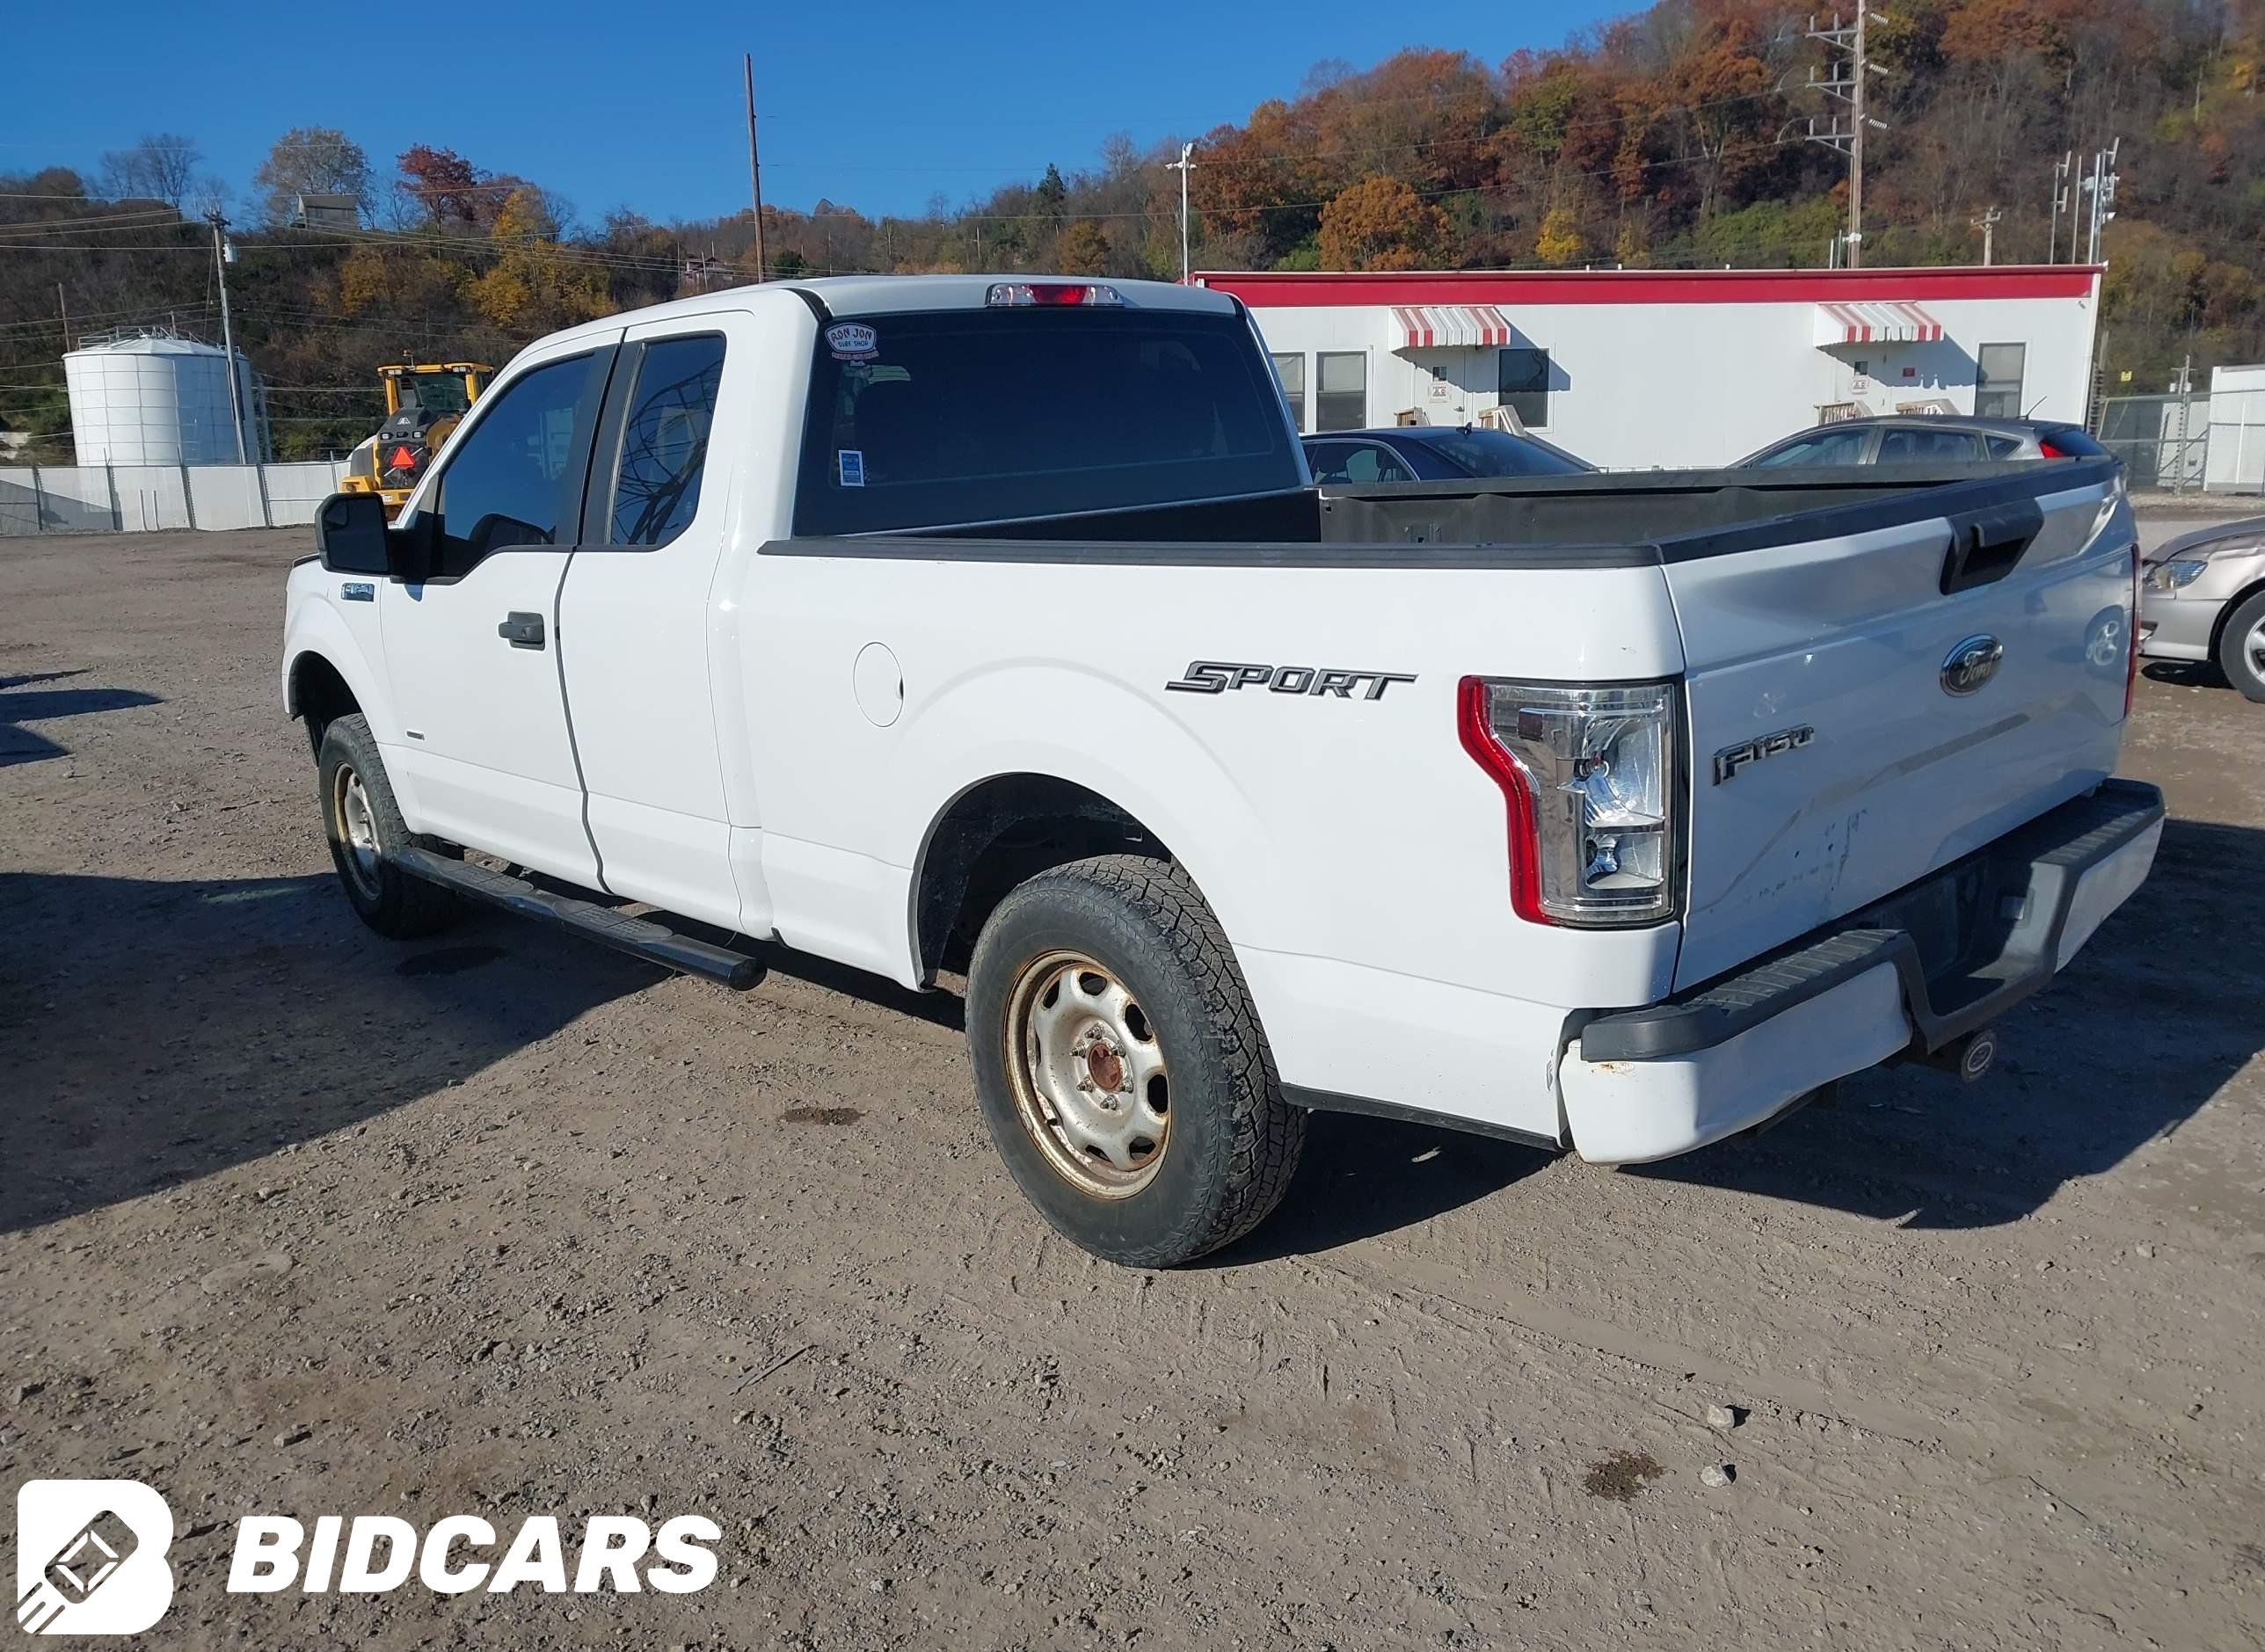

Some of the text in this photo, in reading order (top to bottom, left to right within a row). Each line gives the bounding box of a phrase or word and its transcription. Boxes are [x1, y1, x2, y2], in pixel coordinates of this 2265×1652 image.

[830, 327, 872, 343] RON JON
[1164, 660, 1419, 701] SPORT
[1959, 650, 1999, 685] Ford
